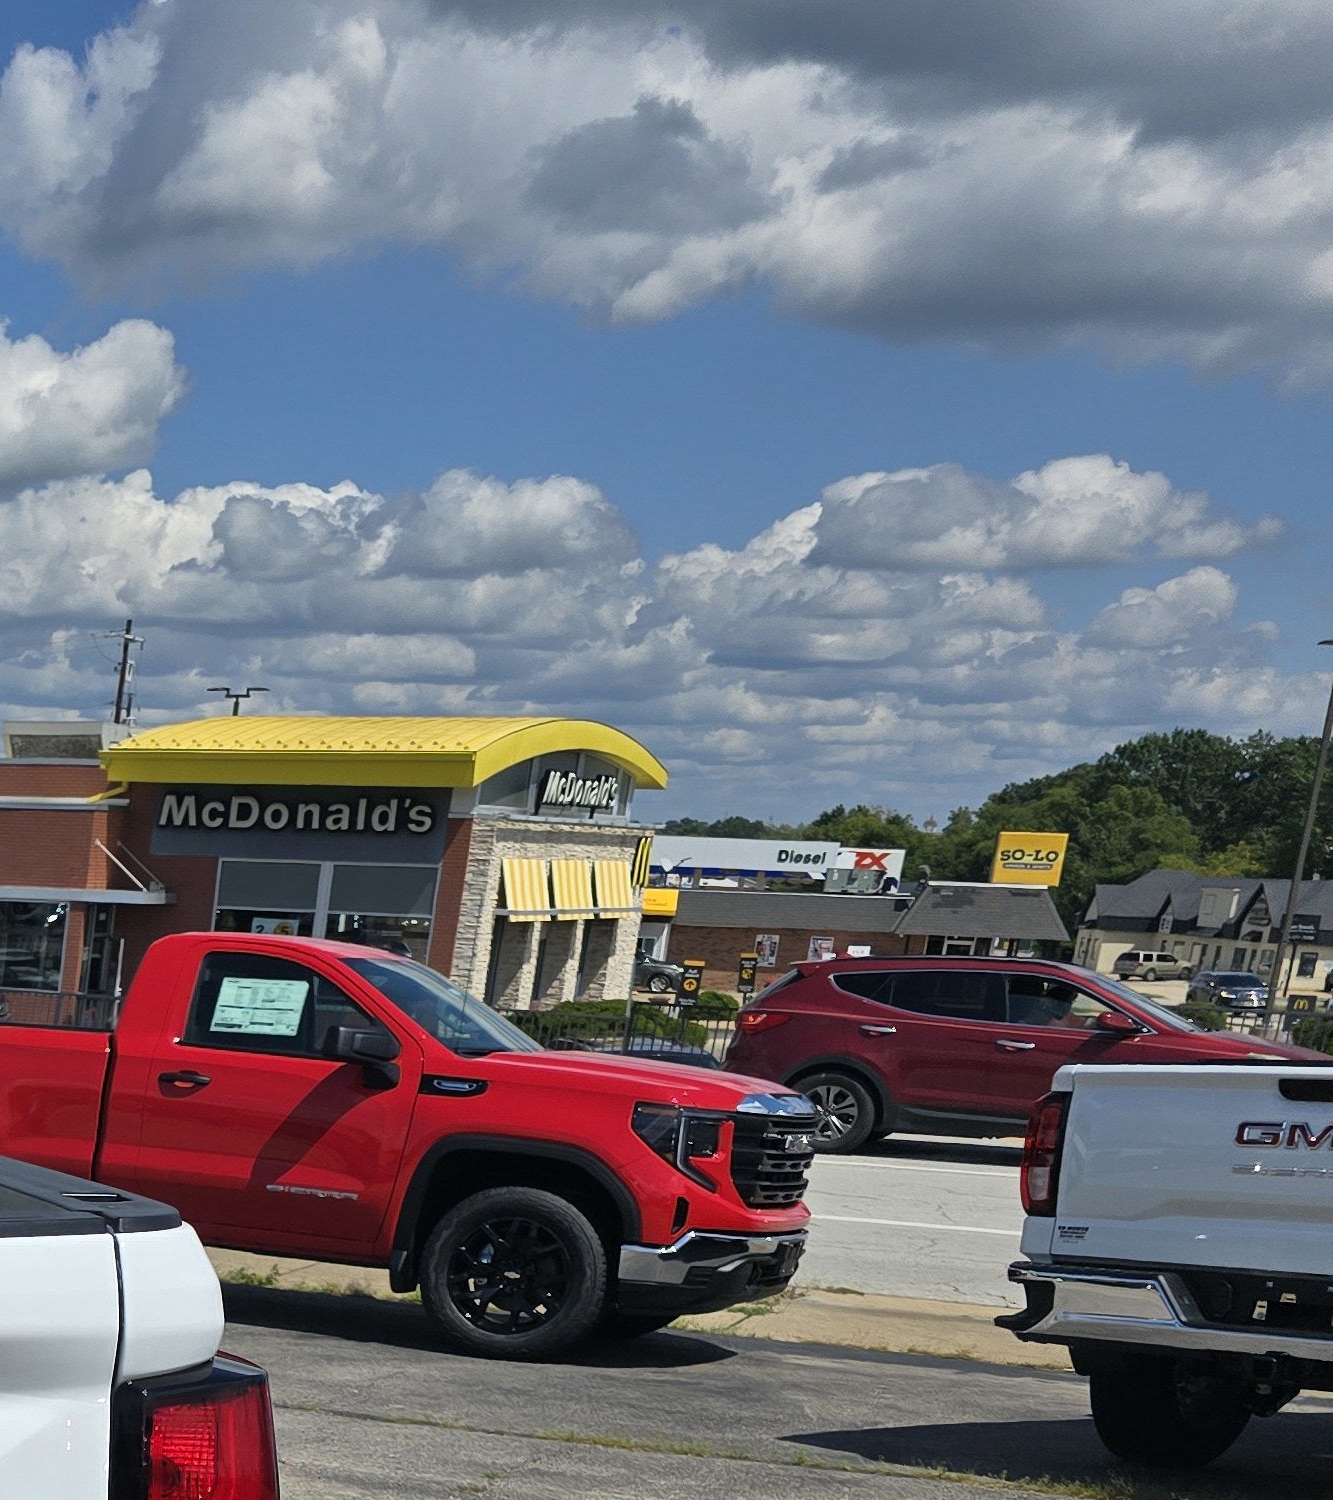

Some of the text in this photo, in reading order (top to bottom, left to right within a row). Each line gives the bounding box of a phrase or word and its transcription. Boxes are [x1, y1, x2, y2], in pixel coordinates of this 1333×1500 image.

[542, 770, 618, 808] McDonald's
[158, 794, 433, 834] McDonald's
[777, 850, 827, 865] Diesel
[1000, 848, 1059, 862] SO-LO
